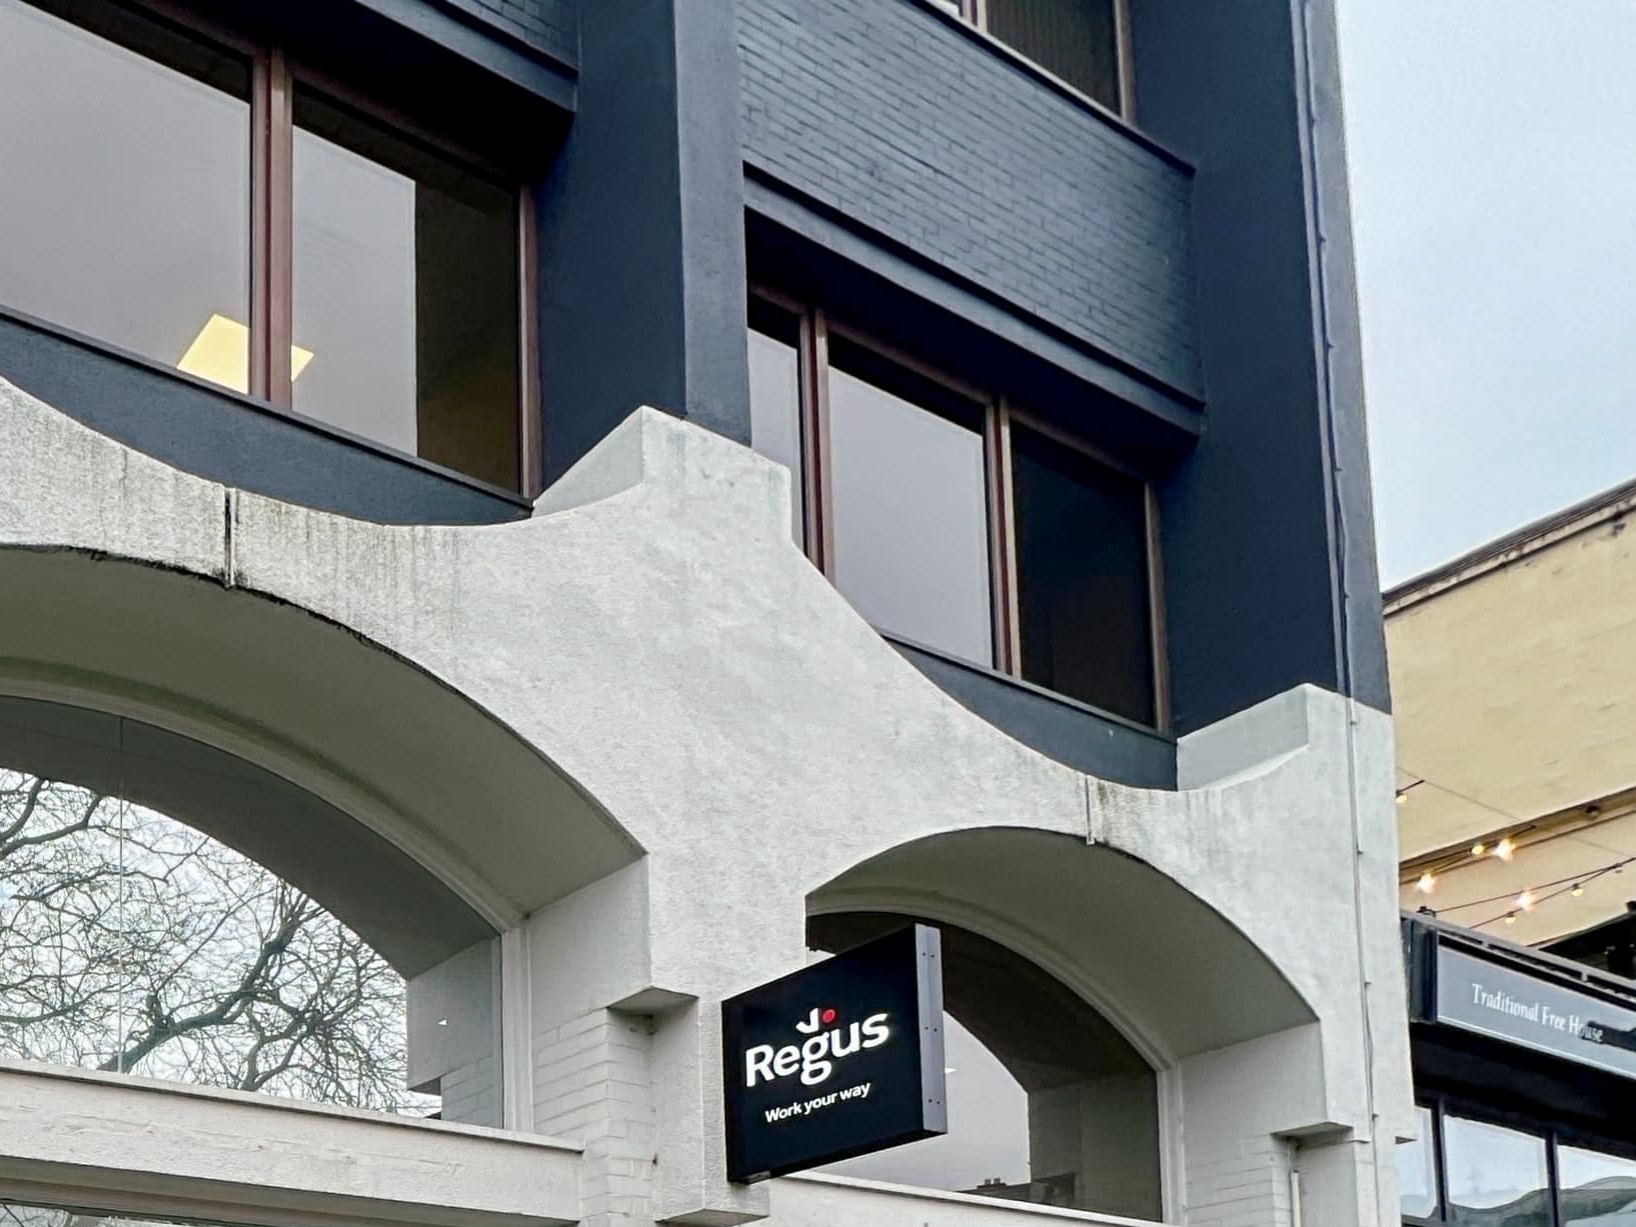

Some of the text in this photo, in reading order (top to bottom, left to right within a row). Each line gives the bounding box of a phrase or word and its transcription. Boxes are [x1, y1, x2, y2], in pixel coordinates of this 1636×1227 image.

[1472, 983, 1539, 1022] Traditional
[1541, 1005, 1567, 1031] Free
[745, 1013, 890, 1087] Regus
[765, 1082, 871, 1123] Work your way
